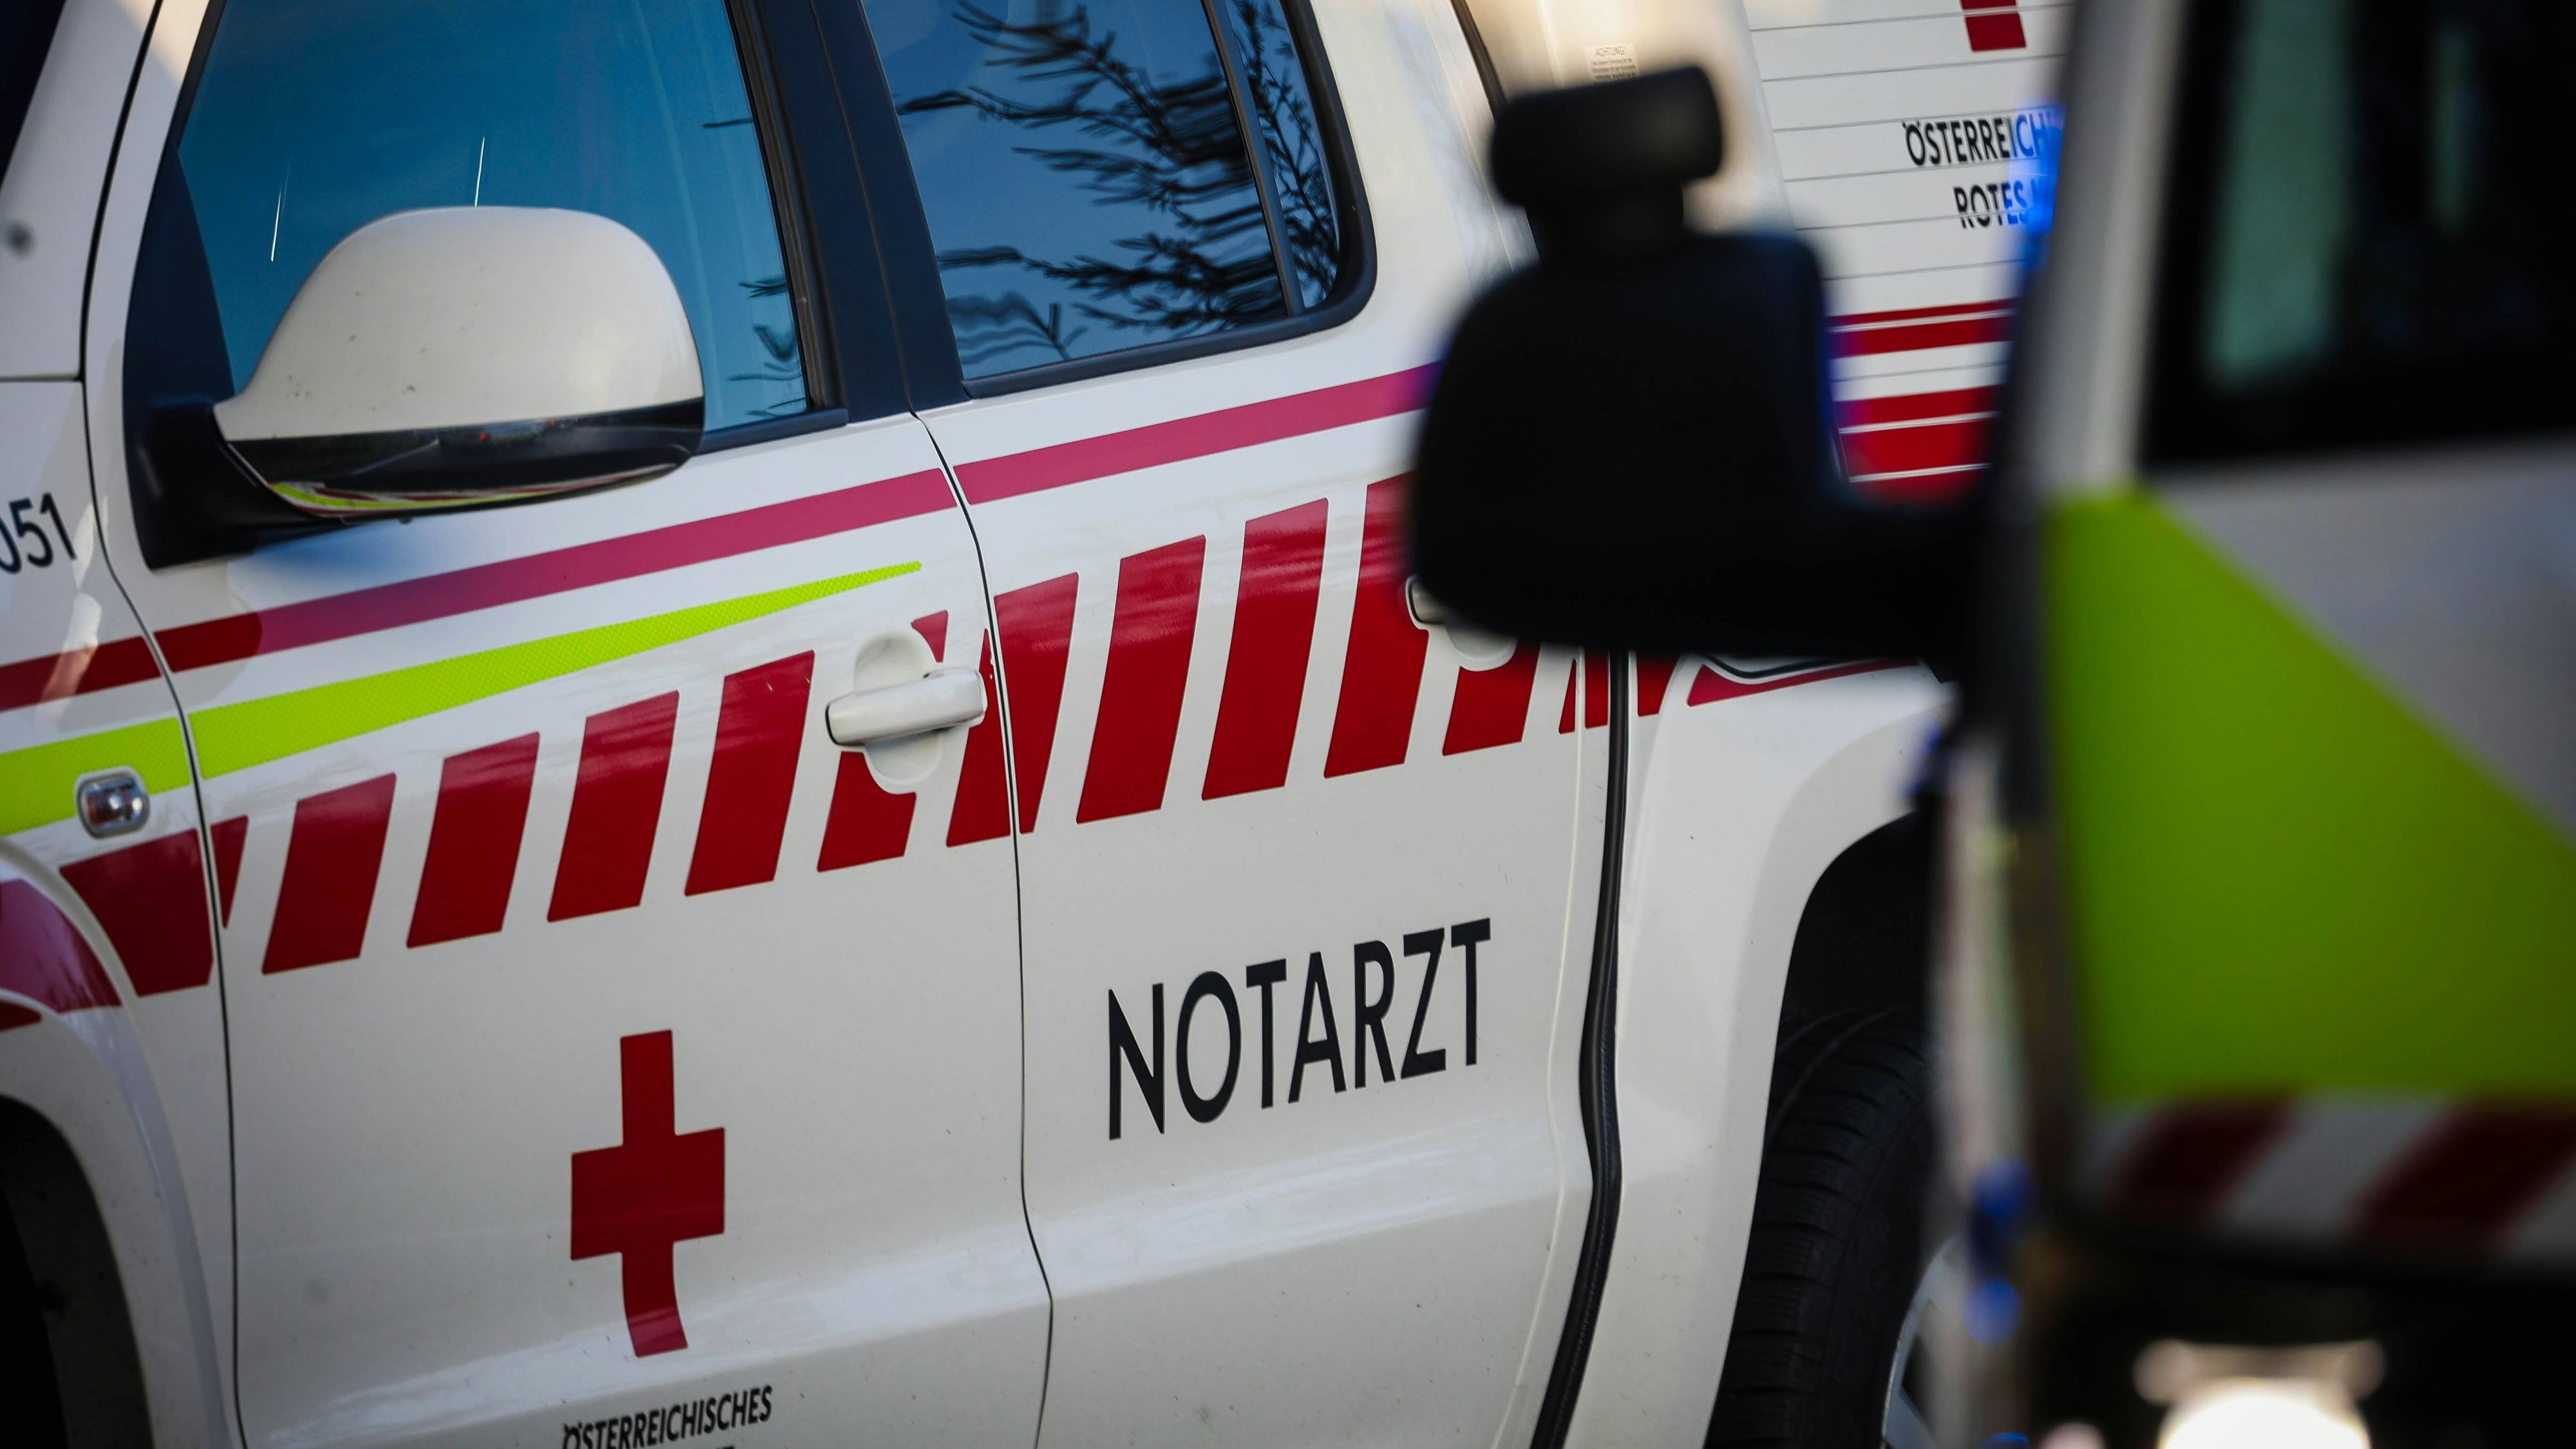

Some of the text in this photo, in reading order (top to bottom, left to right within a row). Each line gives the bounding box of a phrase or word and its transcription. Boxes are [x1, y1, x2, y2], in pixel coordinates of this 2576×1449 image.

[1901, 114, 2052, 167] ÖSTERREICH
[1952, 180, 2030, 229] ROTES
[1108, 918, 1491, 1141] NOTARZT
[562, 1384, 773, 1449] ÖSTERREICHISCHES
